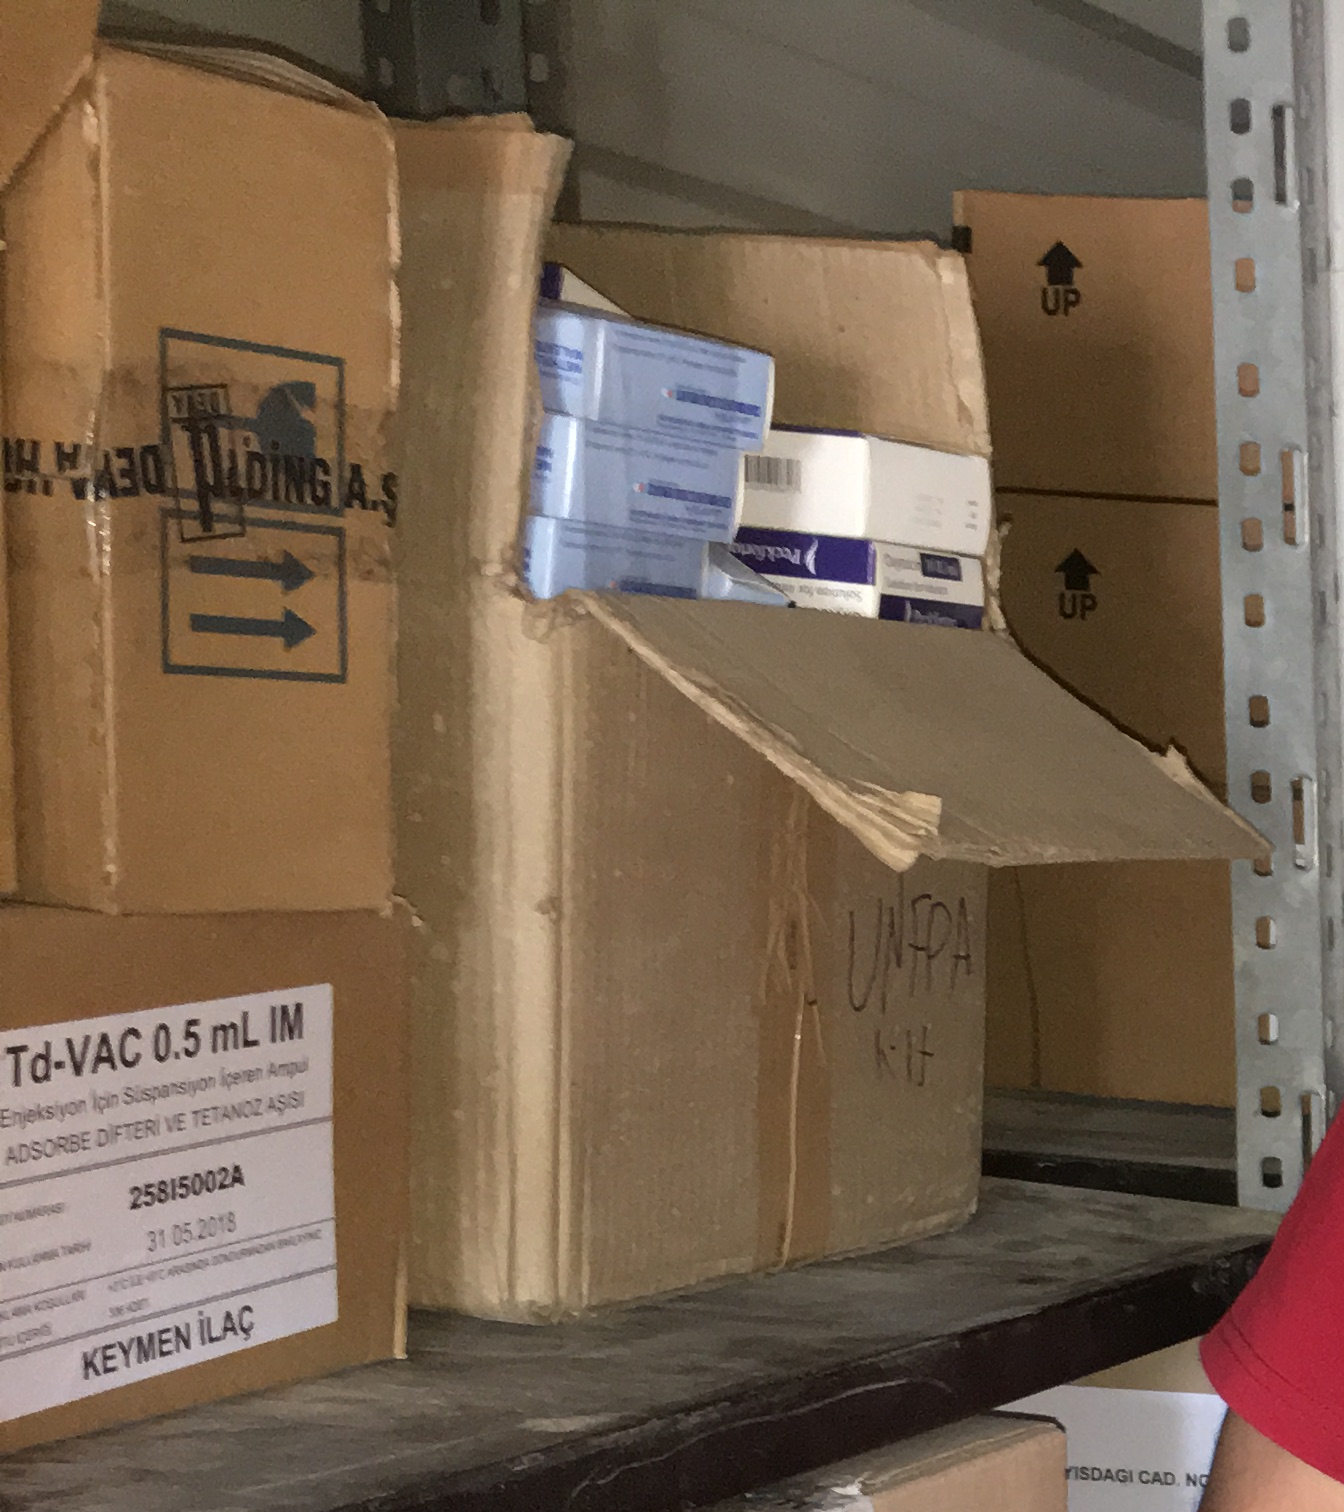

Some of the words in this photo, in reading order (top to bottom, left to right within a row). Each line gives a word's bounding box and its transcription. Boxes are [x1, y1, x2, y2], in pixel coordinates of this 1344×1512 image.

[1041, 287, 1081, 316] UP
[1059, 591, 1097, 622] UP
[6, 1027, 142, 1087] Td-VAC
[154, 1018, 201, 1063] 0.5
[211, 1010, 260, 1054] mL
[270, 1002, 305, 1044] IM
[6, 1130, 91, 1167] ADSORBE
[164, 1112, 187, 1133] VE
[191, 1098, 264, 1128] TETANOZ
[147, 1211, 237, 1252] 3105.2018
[83, 1321, 192, 1381] KEYMEN
[198, 1304, 256, 1342] İLAÇ
